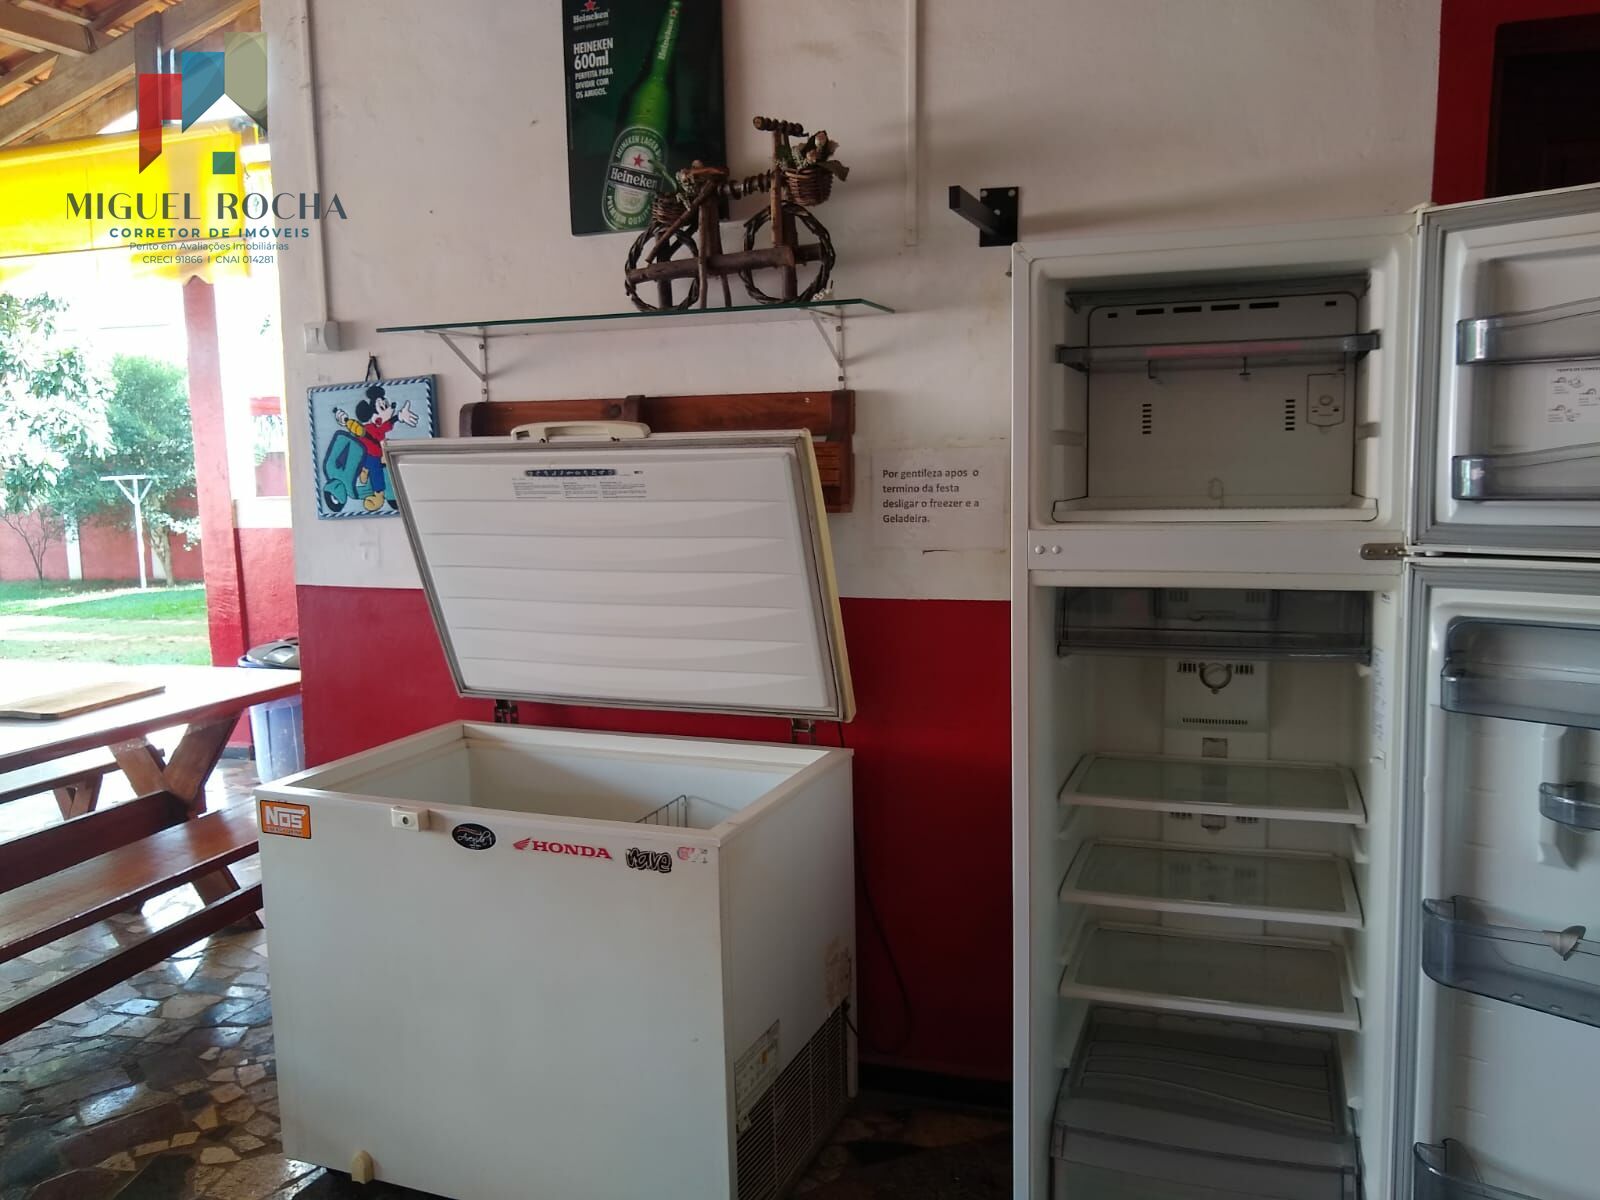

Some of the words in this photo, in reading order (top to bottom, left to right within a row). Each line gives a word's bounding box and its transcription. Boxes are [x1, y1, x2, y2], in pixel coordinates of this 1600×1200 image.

[573, 10, 609, 24] Heineken
[573, 37, 614, 55] HEINEKEN
[574, 50, 609, 70] 600ml
[599, 67, 614, 77] PARA
[575, 79, 596, 90] DIVIDIR
[596, 77, 610, 86] COM
[575, 90, 584, 99] OS
[882, 469, 899, 478] Por
[900, 468, 943, 480] gentileza
[945, 469, 968, 479] apos
[972, 469, 979, 477] o
[882, 484, 920, 493] termino
[922, 484, 934, 493] da
[936, 483, 960, 493] festa
[882, 499, 919, 510] desligar
[930, 498, 963, 508] freezer
[965, 500, 972, 508] e
[973, 500, 980, 508] a
[882, 514, 930, 523] Geladeira.
[265, 805, 306, 829] NOS
[532, 840, 613, 860] HONDA
